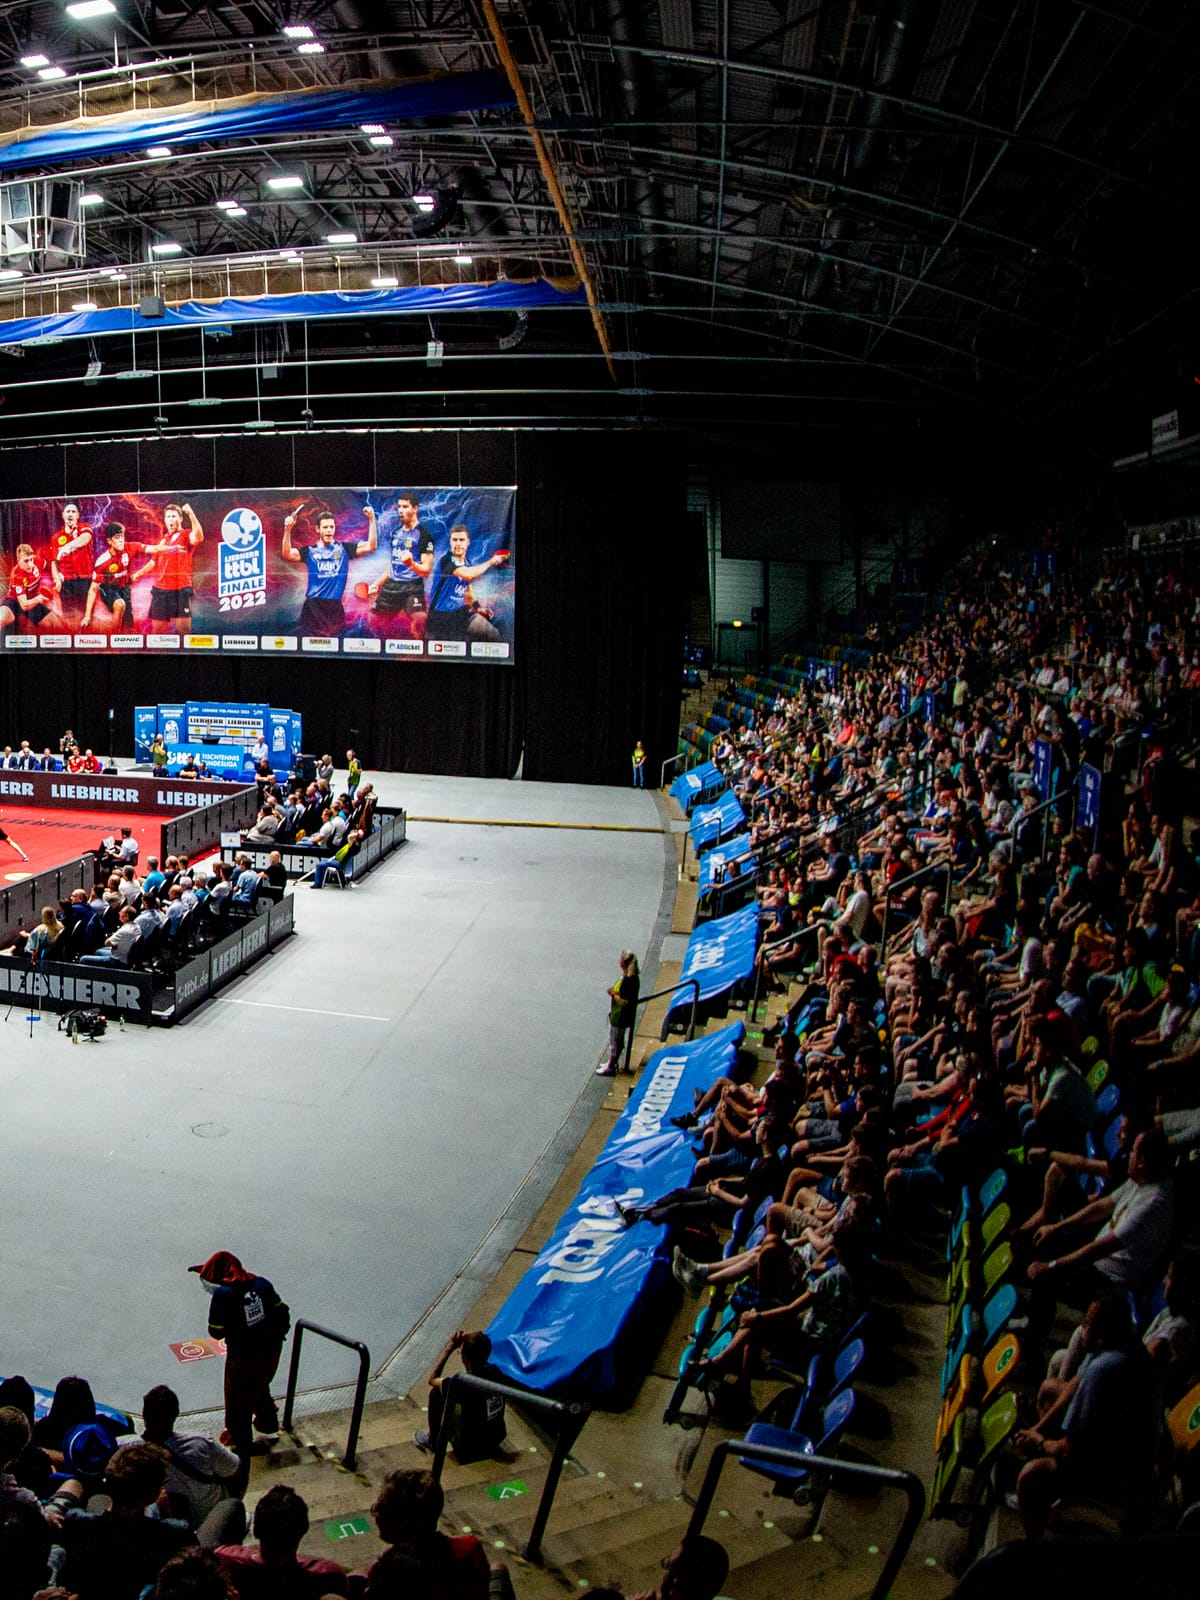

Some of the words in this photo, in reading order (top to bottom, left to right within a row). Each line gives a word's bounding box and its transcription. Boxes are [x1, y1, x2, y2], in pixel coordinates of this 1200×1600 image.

[224, 550, 259, 562] LIEBHERR
[224, 557, 260, 579] ttbl
[221, 578, 264, 594] FINALE
[219, 591, 266, 612] 2022
[190, 717, 224, 725] LIEBHERR
[51, 783, 139, 803] LIEBHERR
[212, 924, 267, 981] LIEBHERR
